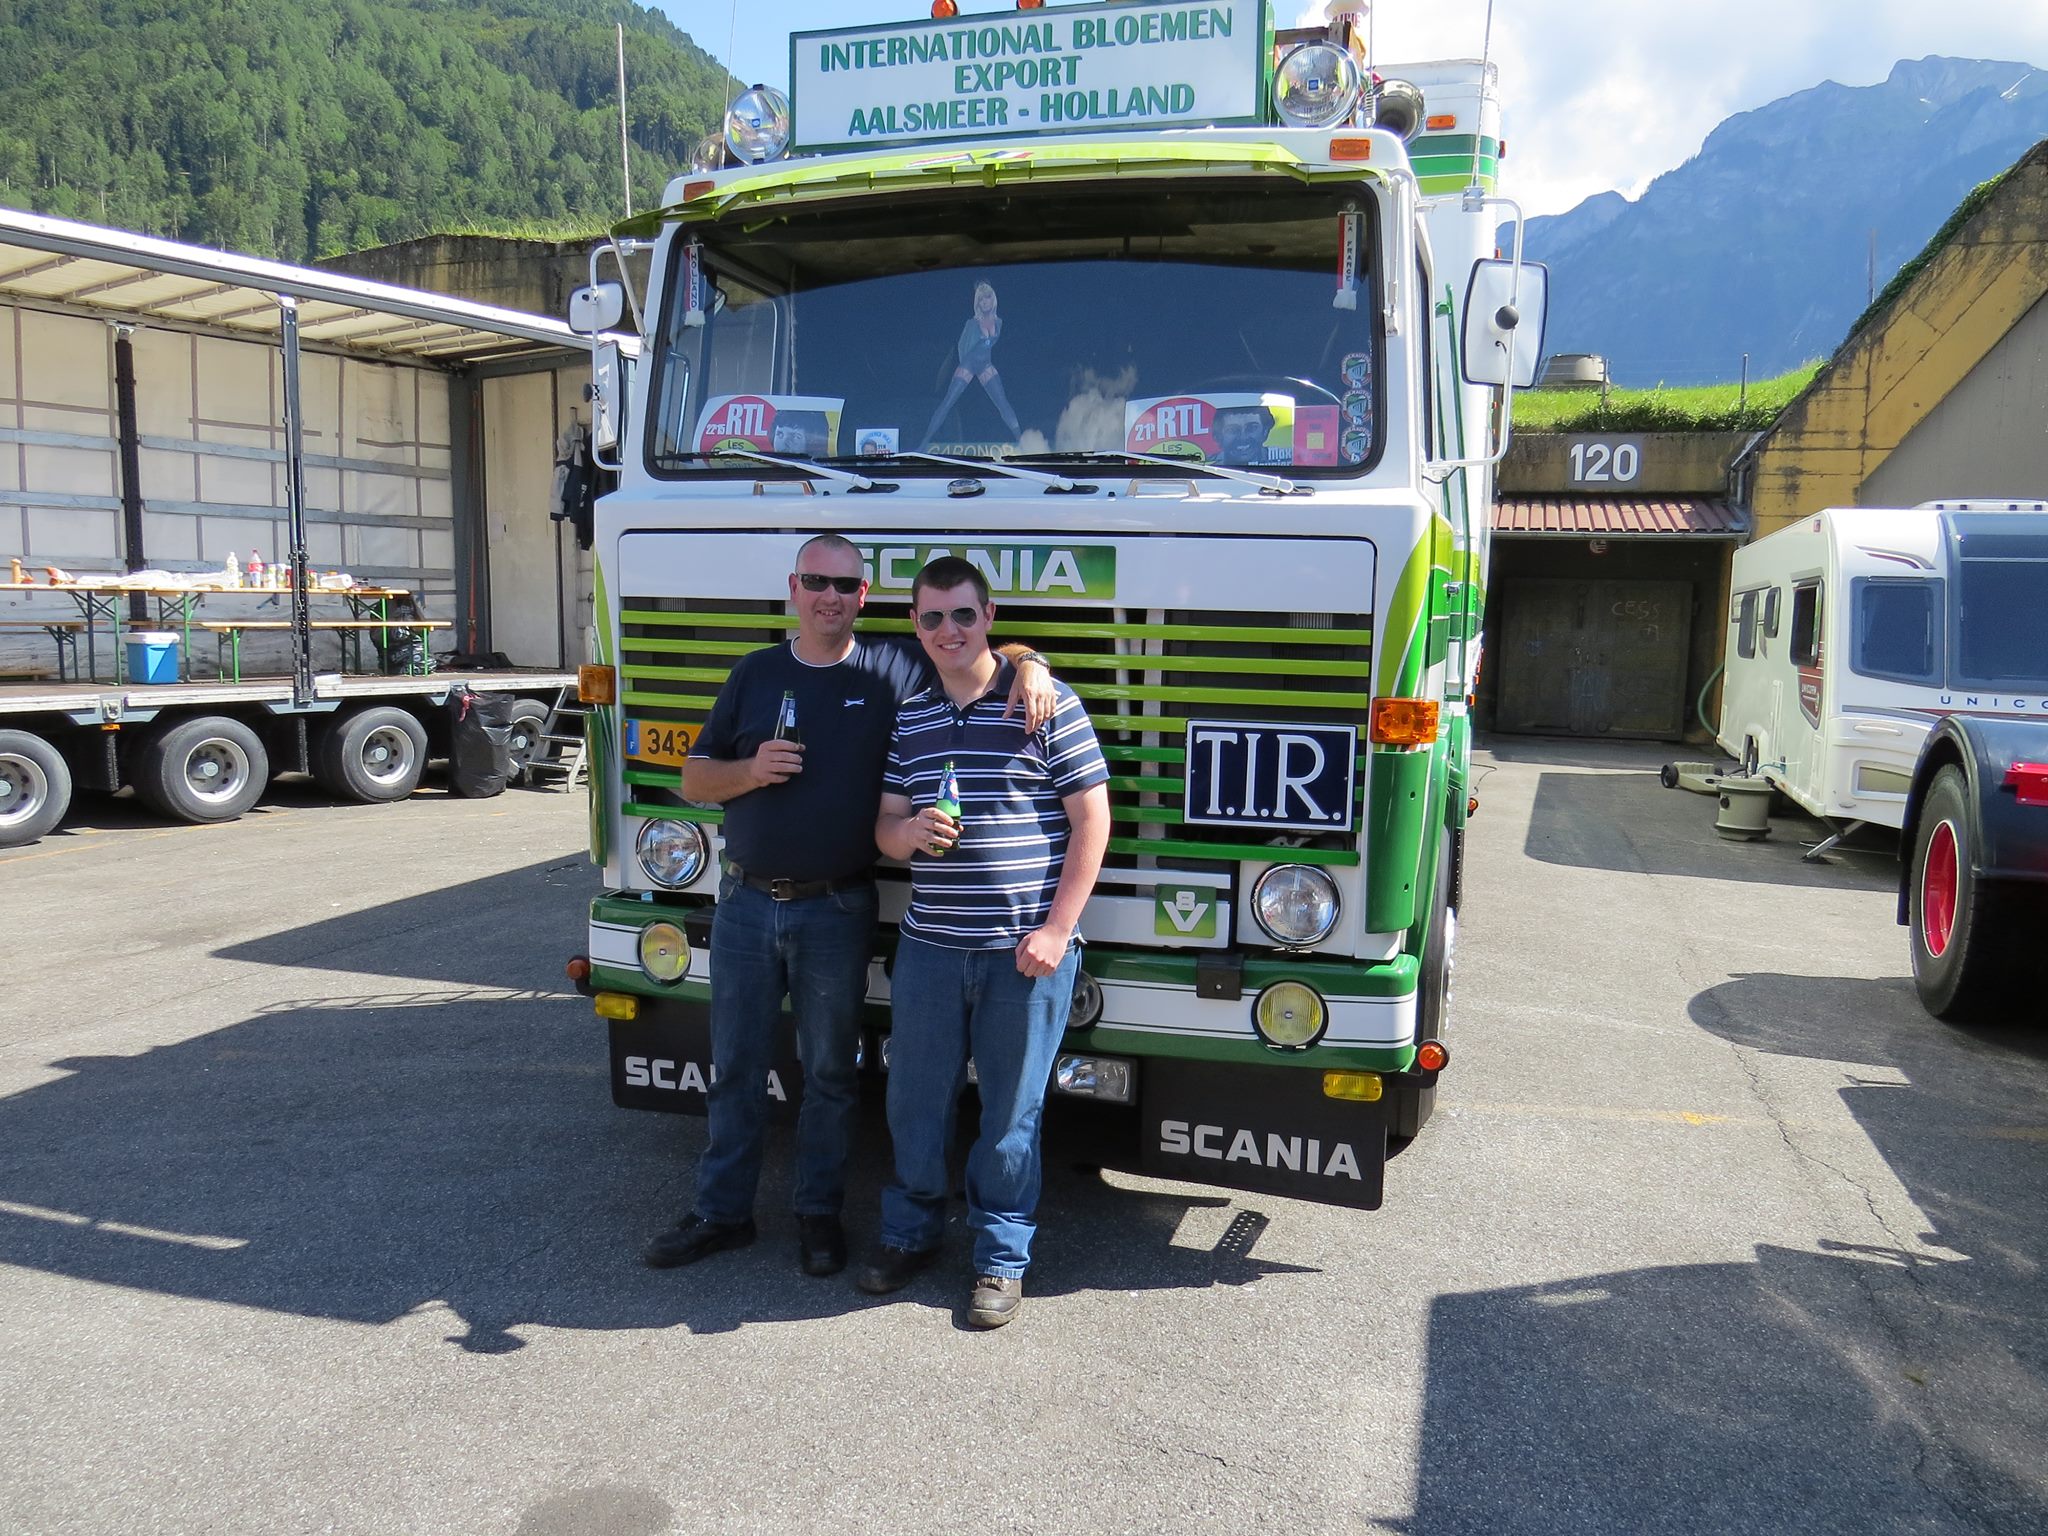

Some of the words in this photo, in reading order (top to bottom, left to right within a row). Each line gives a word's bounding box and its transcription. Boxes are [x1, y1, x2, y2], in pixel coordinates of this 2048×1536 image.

[820, 22, 1062, 72] INTERNATIONAL
[1073, 7, 1232, 51] BLOEMEN
[954, 55, 1082, 94] EXPORT
[848, 97, 1008, 136] AALSMEER
[1040, 83, 1195, 123] HOLLAND
[690, 252, 698, 308] HOLLAND
[726, 403, 768, 436] RTL
[1157, 403, 1209, 439] RTL
[1162, 443, 1183, 453] LES
[1568, 443, 1639, 483] 120
[859, 547, 1086, 593] CNIA
[647, 728, 690, 757] 343
[1196, 731, 1342, 821] T.I.R.
[625, 1055, 787, 1102] SCAA
[1160, 1119, 1362, 1181] SCANIA
